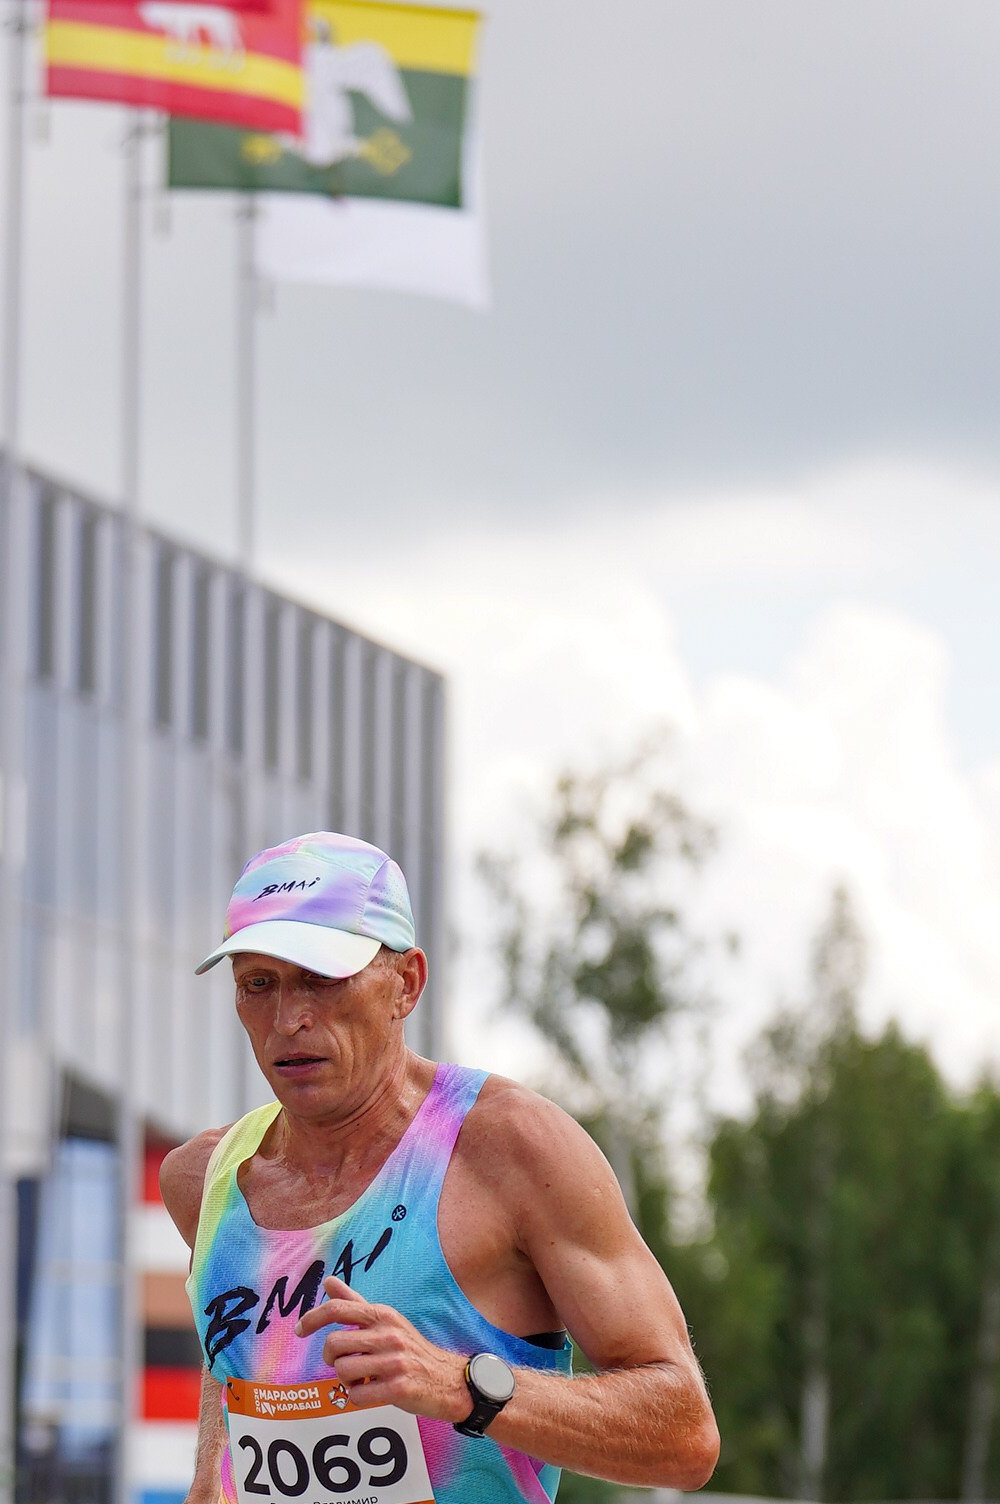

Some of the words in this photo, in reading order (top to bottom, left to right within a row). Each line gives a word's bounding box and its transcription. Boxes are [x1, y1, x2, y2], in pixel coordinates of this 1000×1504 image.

[259, 1387, 319, 1402] МАРАФОН
[276, 1400, 321, 1412] КАРАБАШ
[238, 1427, 407, 1497] 2069
